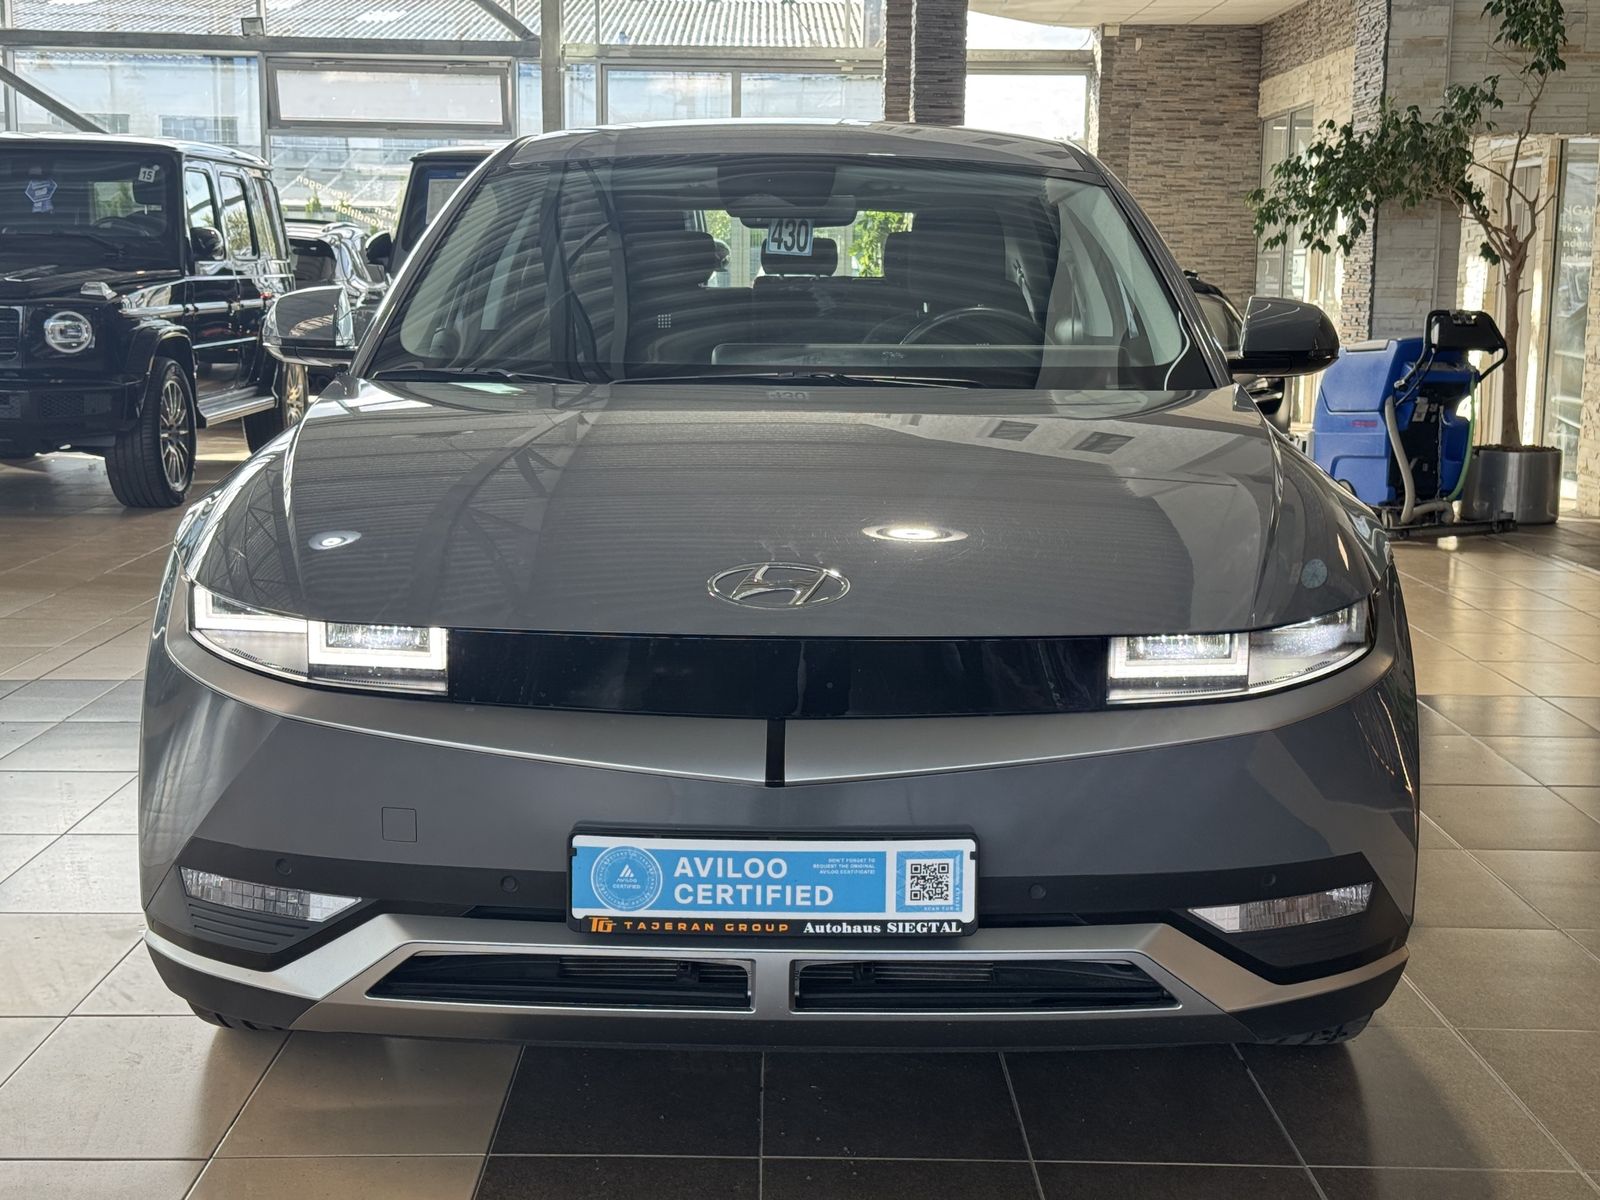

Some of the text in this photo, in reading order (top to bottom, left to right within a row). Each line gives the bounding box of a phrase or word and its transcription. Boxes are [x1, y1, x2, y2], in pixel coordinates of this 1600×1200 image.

[142, 170, 154, 181] 15
[770, 218, 810, 253] 430
[674, 856, 788, 879] AVILOO
[674, 883, 834, 906] CERTIFIED
[624, 922, 714, 932] TAJERAN
[725, 923, 790, 932] GROUP
[803, 922, 882, 934] Autohaus
[886, 922, 962, 934] SIEGTAL
